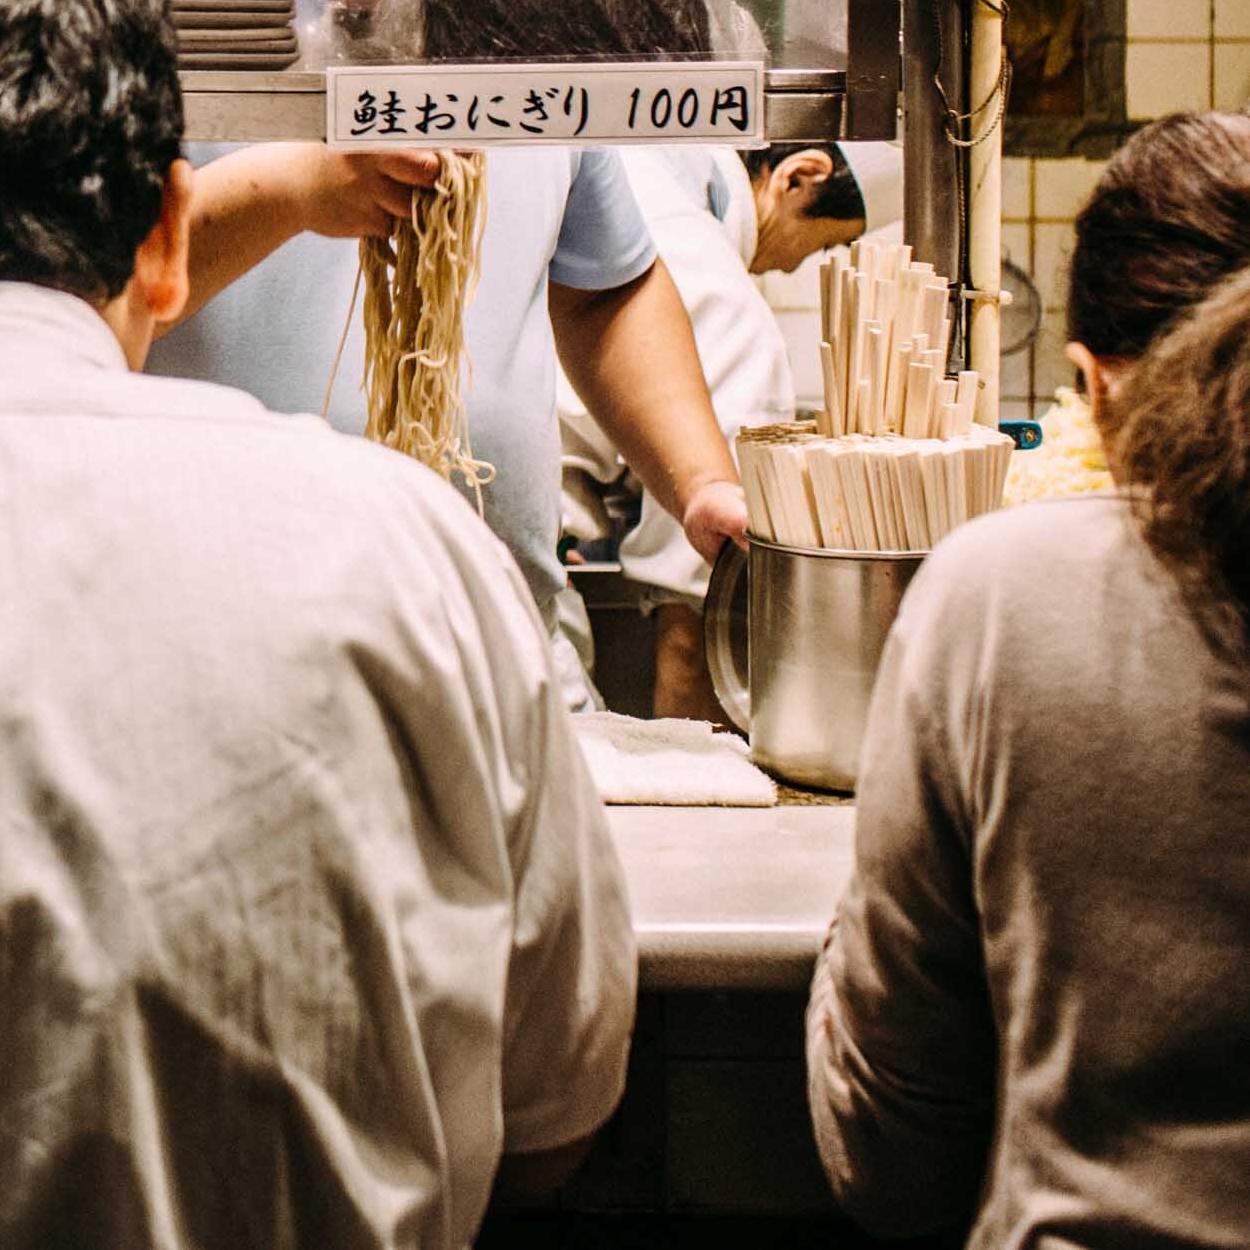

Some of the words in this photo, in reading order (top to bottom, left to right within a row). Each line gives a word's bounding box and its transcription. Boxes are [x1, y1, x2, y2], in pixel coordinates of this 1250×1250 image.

[350, 85, 595, 139] 鮭おにぎり
[627, 85, 749, 132] 100円
